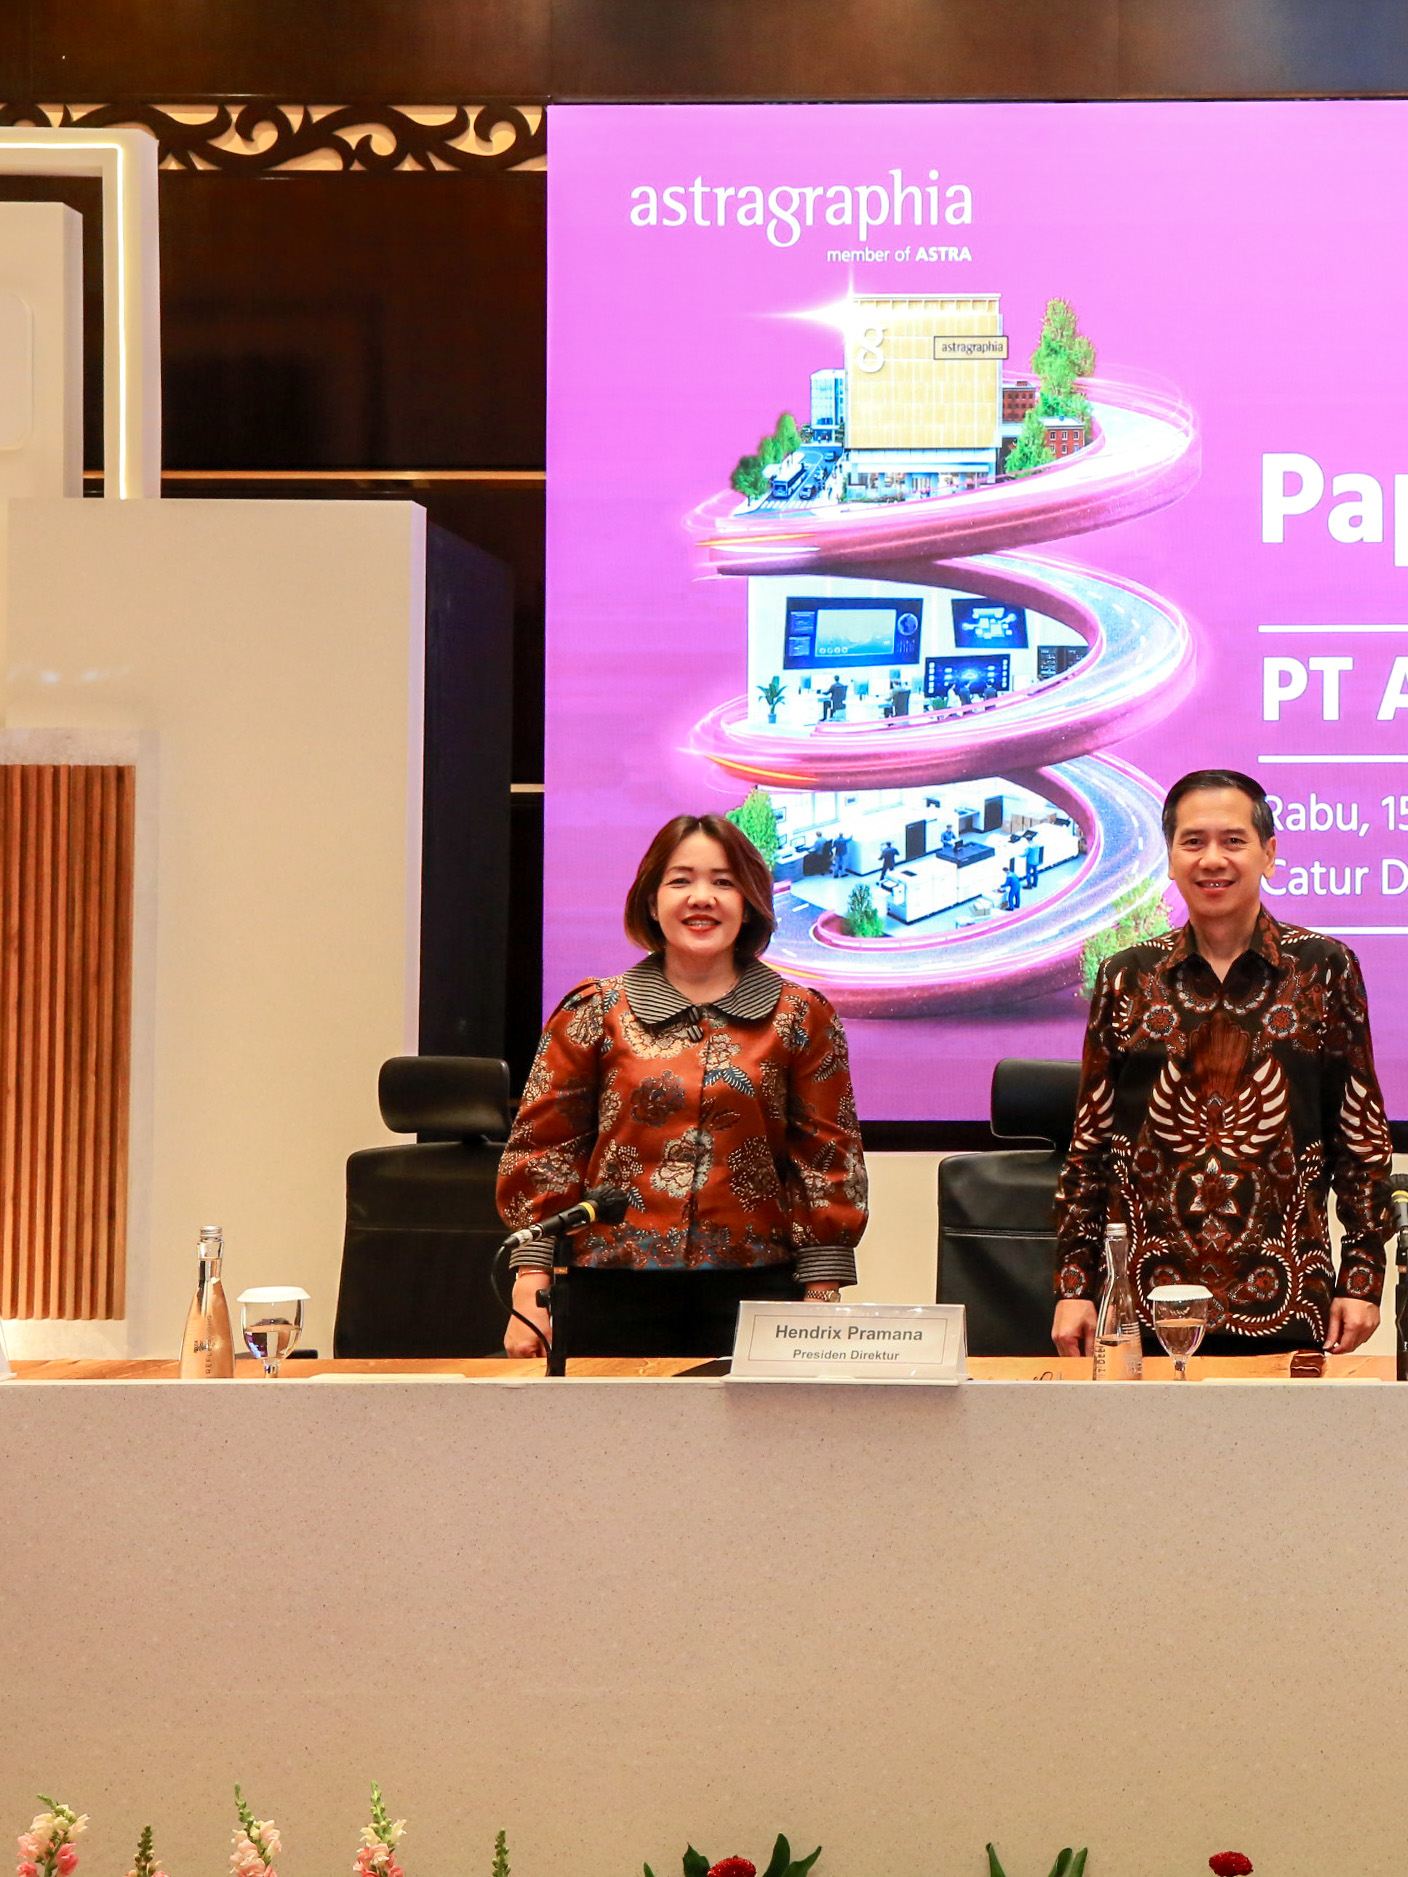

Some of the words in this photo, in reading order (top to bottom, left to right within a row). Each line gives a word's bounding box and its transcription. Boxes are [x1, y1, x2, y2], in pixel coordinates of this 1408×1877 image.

[630, 168, 973, 247] astragraphia
[826, 246, 890, 262] member
[894, 246, 911, 262] of
[915, 246, 972, 262] ASTRA
[941, 340, 1004, 356] astragraphia
[1263, 656, 1353, 721] PT
[1260, 858, 1369, 896] Catur
[775, 1324, 841, 1340] Hendrix
[847, 1326, 923, 1341] Pramana
[793, 1349, 846, 1360] Presiden
[850, 1350, 900, 1361] Direktur
